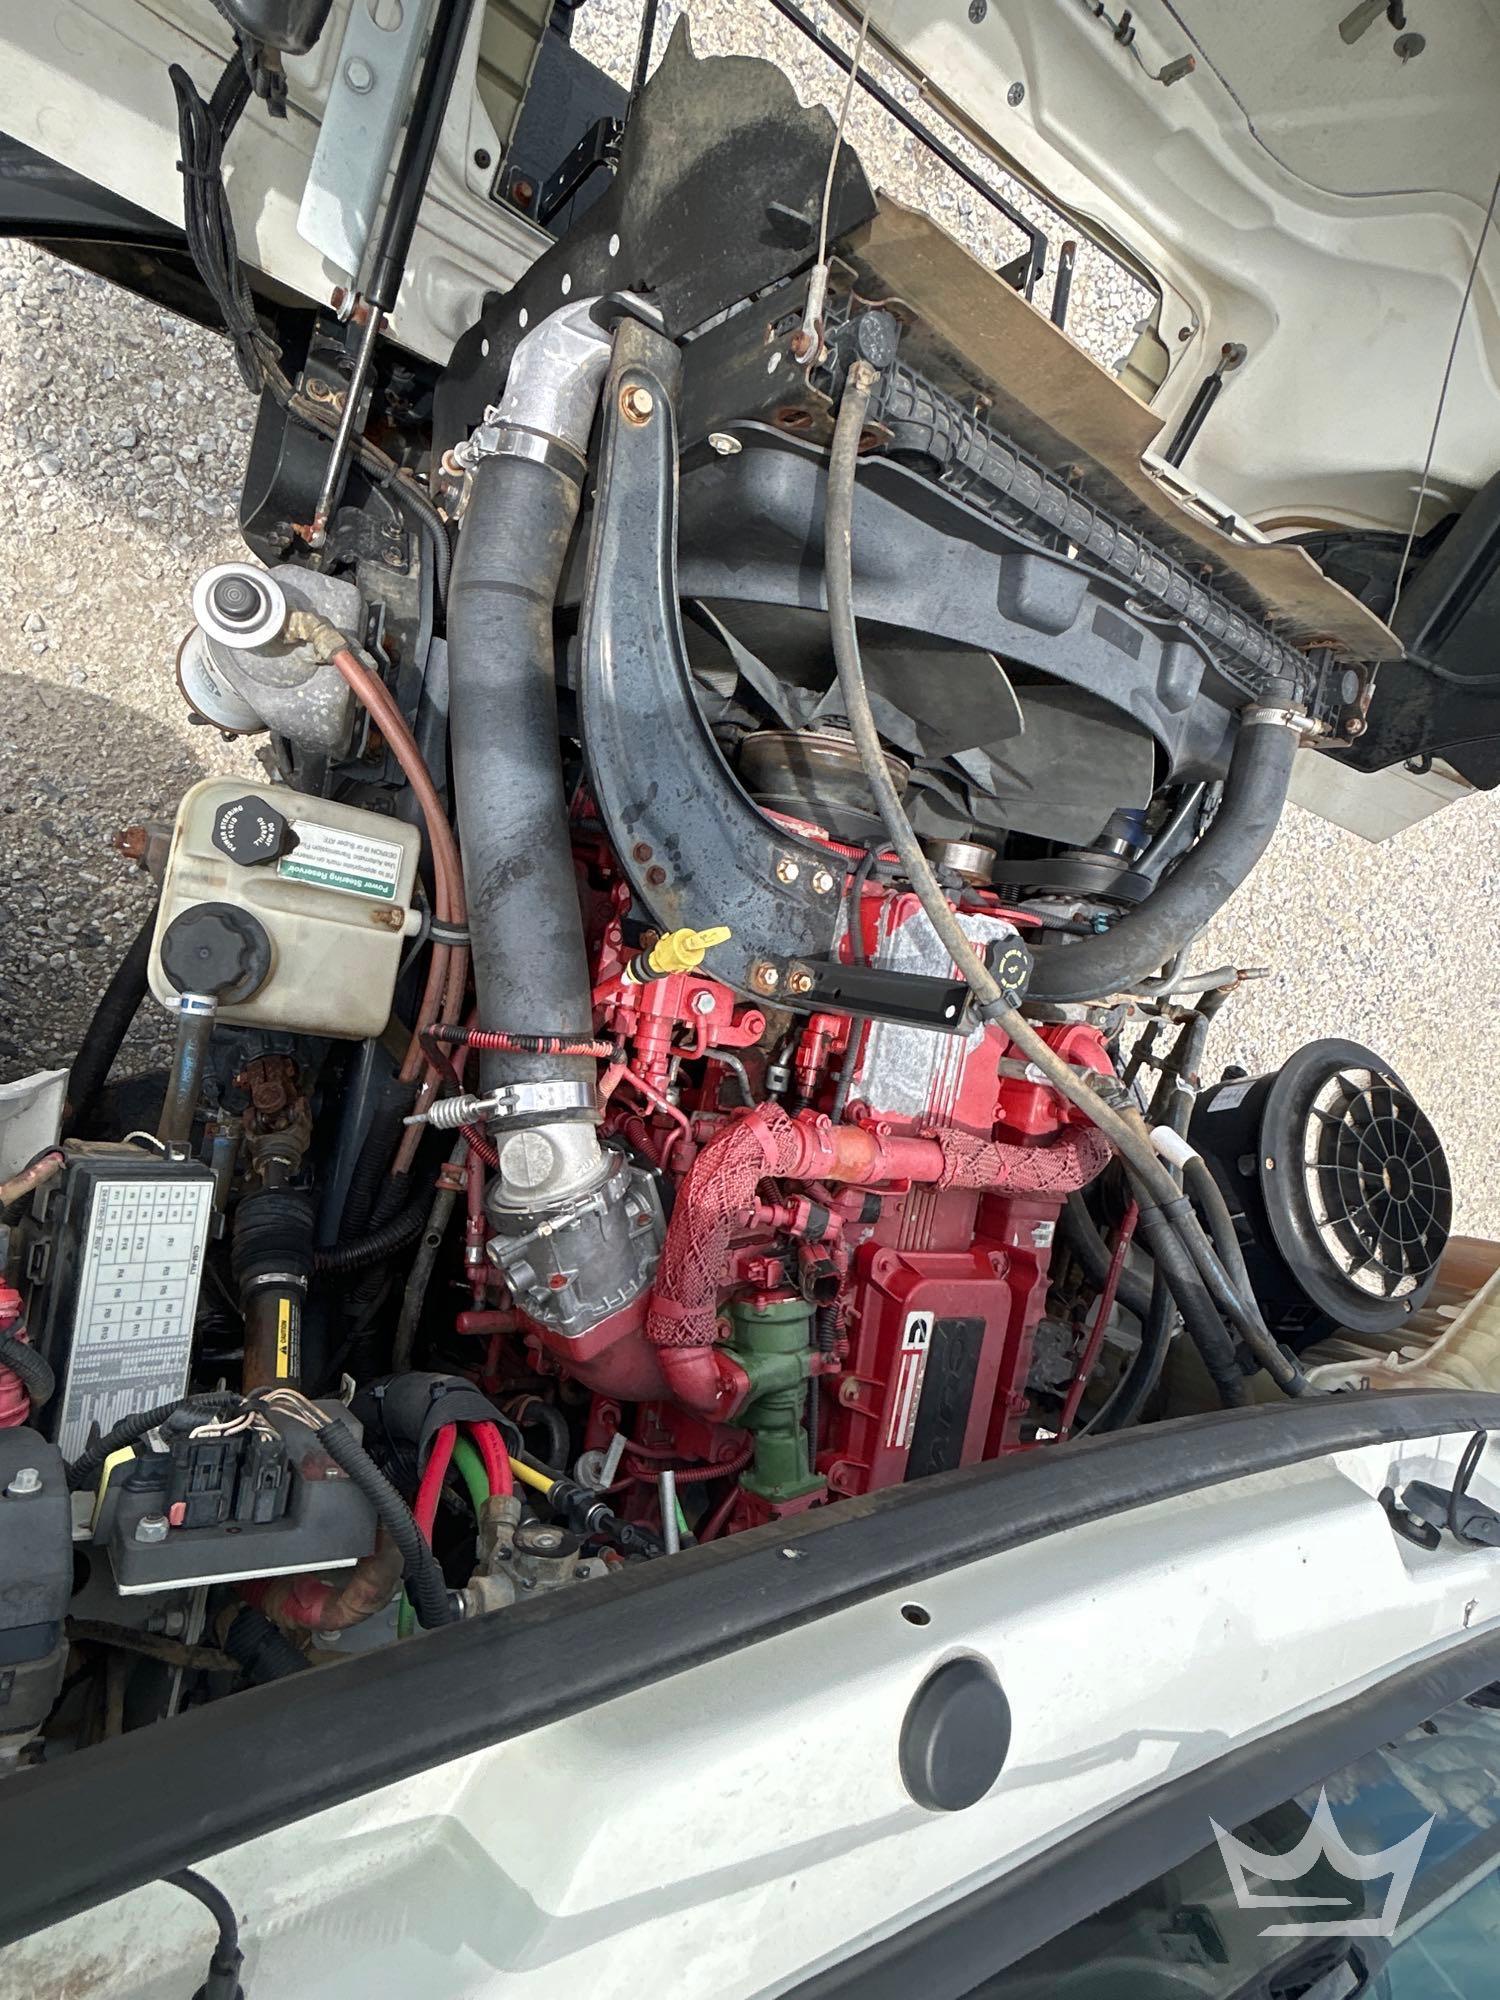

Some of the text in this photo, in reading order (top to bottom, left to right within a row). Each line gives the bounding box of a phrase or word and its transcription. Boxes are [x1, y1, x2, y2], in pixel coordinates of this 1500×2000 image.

[220, 805, 244, 852] POWER STEERING
[228, 817, 238, 838] FLUID
[253, 817, 268, 846] OVERFILL
[265, 822, 275, 847] DO NOT
[337, 840, 355, 850] Super
[312, 844, 351, 861] Transmission
[326, 859, 341, 867] mark
[354, 854, 382, 866] Automatic
[384, 861, 395, 869] Use
[342, 862, 376, 874] appropriate
[288, 865, 389, 893] Power Steering Reservoir
[94, 1236, 102, 1250] REV
[121, 1237, 129, 1251] F14
[117, 1269, 124, 1278] R4
[132, 1324, 140, 1337] R11
